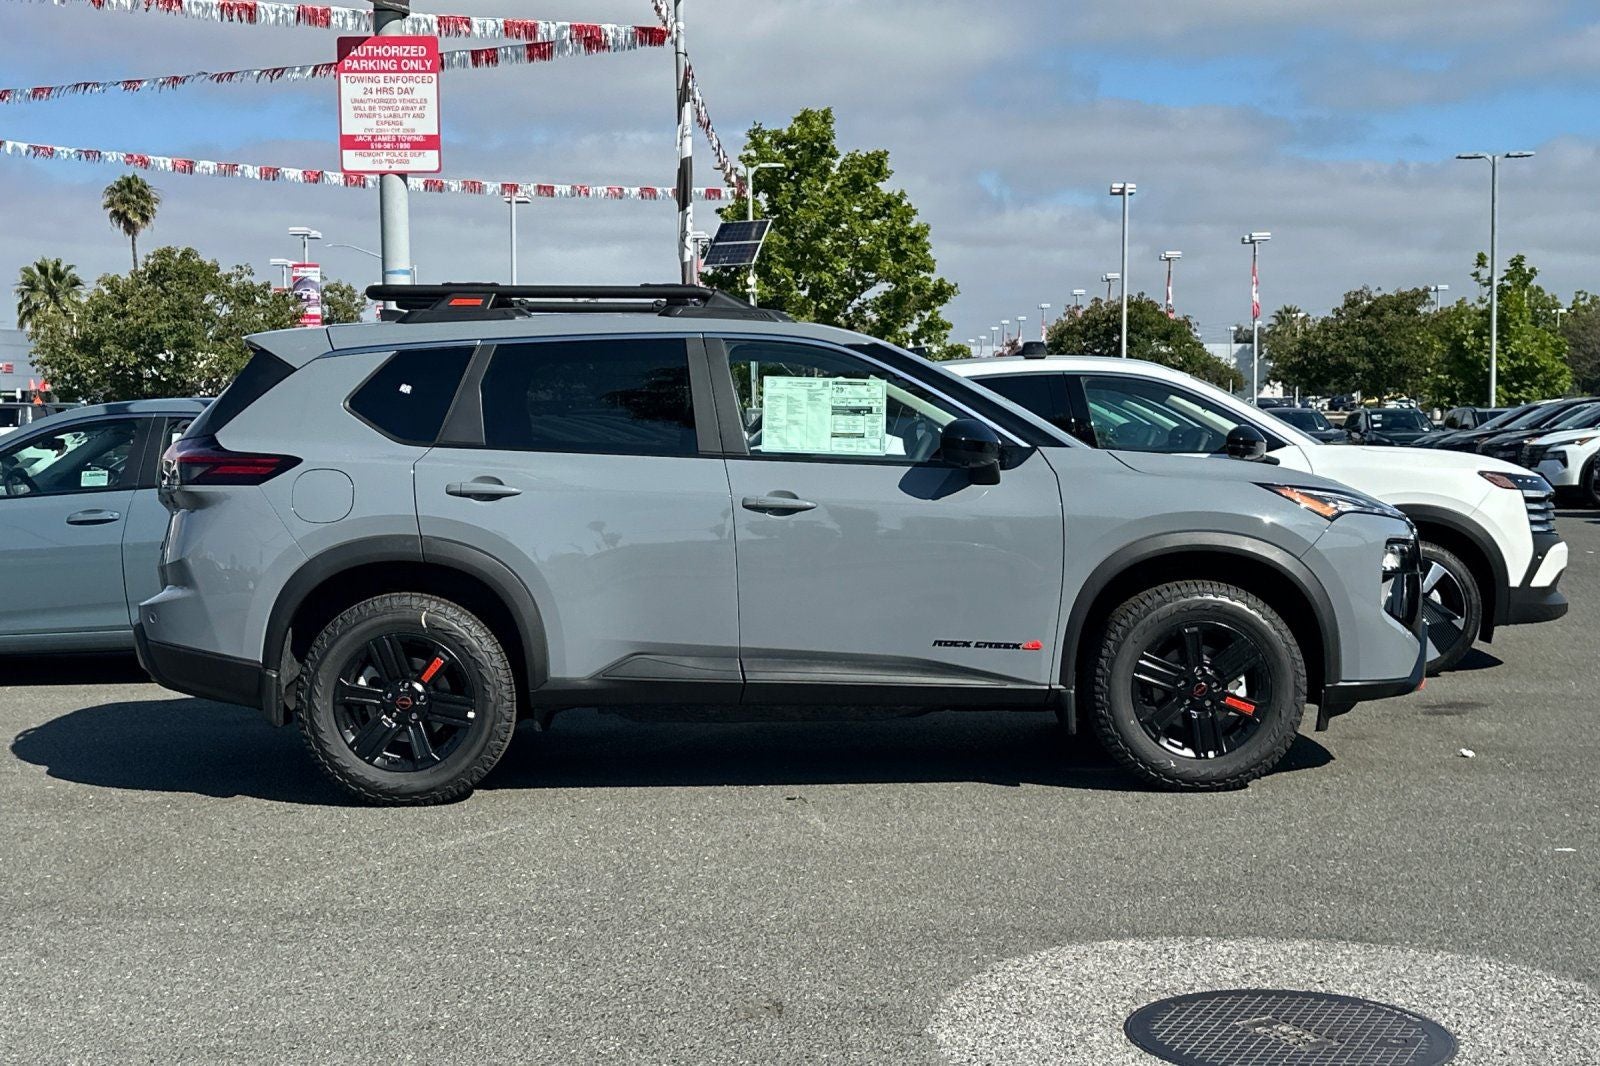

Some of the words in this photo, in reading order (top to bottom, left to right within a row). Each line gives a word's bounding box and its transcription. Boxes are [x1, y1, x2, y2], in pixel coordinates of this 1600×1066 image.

[349, 45, 427, 57] AUTHORIZED
[344, 59, 398, 71] PARKING
[400, 59, 433, 71] ONLY
[344, 75, 381, 84] TOWING
[383, 75, 434, 84] ENFORCED
[363, 87, 373, 95] 24
[375, 87, 395, 95] HRS
[397, 87, 415, 95] DAY
[932, 639, 973, 648] ROCK
[973, 641, 1022, 650] CREEK
